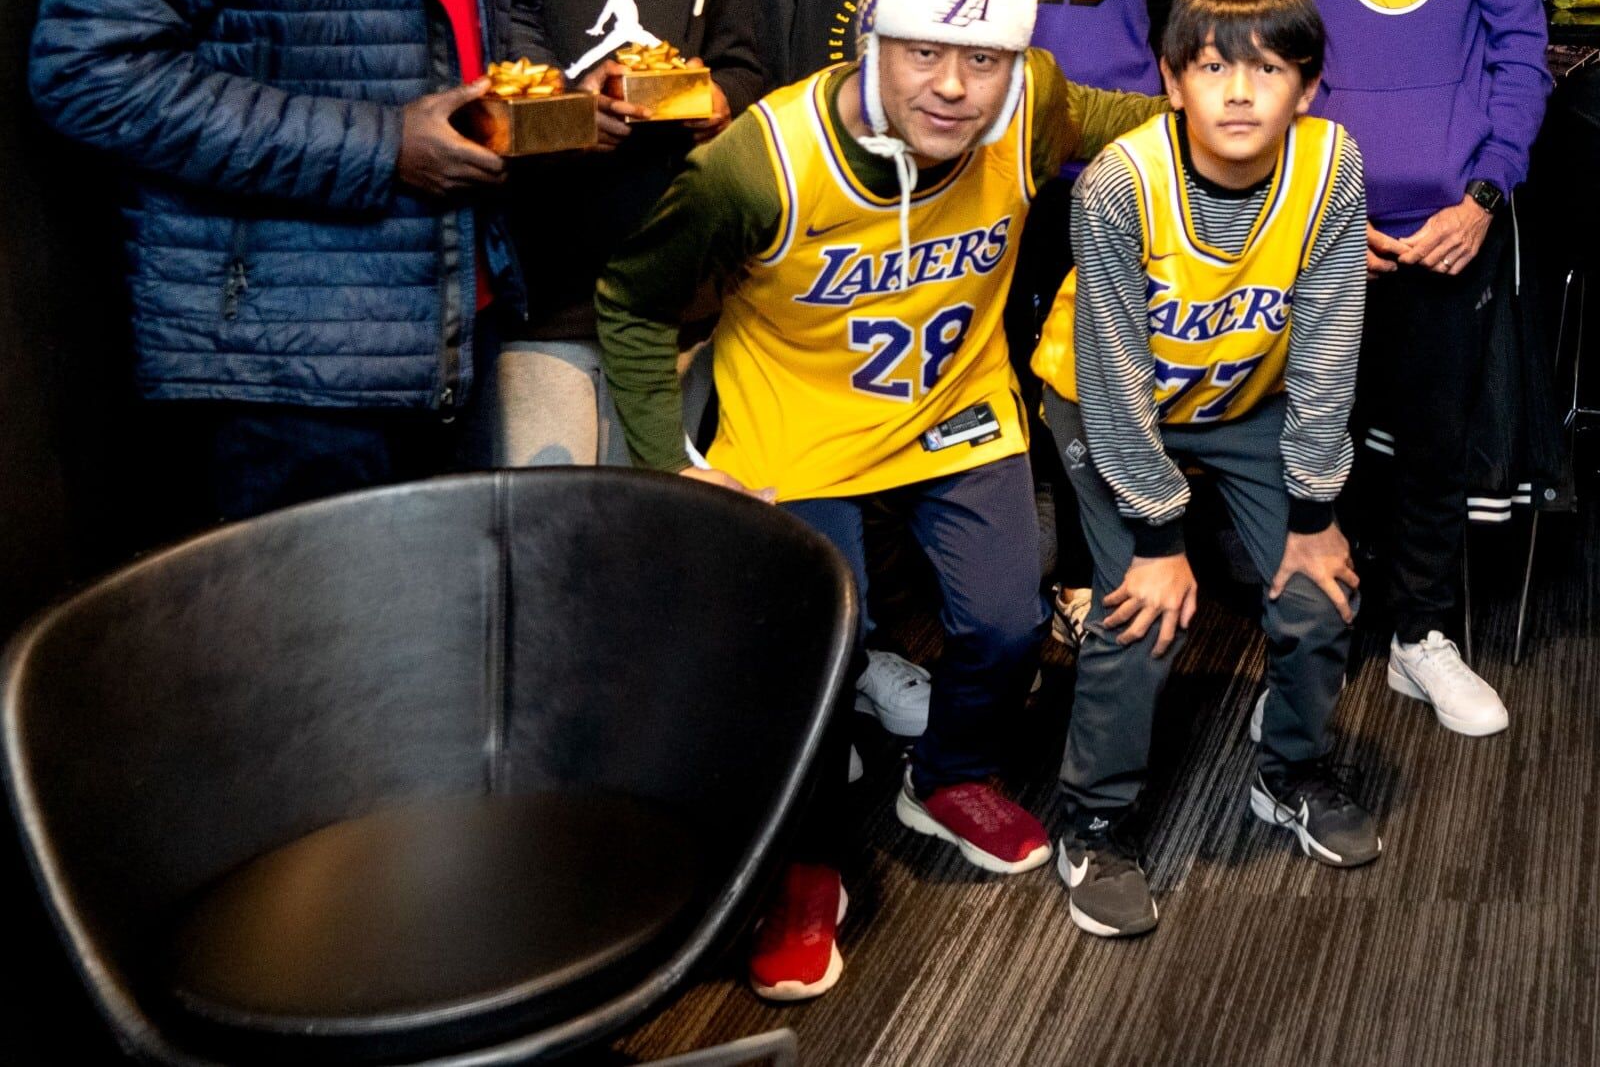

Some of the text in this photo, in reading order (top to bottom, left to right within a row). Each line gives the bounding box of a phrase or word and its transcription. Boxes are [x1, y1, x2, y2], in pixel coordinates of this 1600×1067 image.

[793, 215, 1012, 306] LAKERS
[848, 301, 975, 404] 28
[1154, 352, 1266, 422] 77
